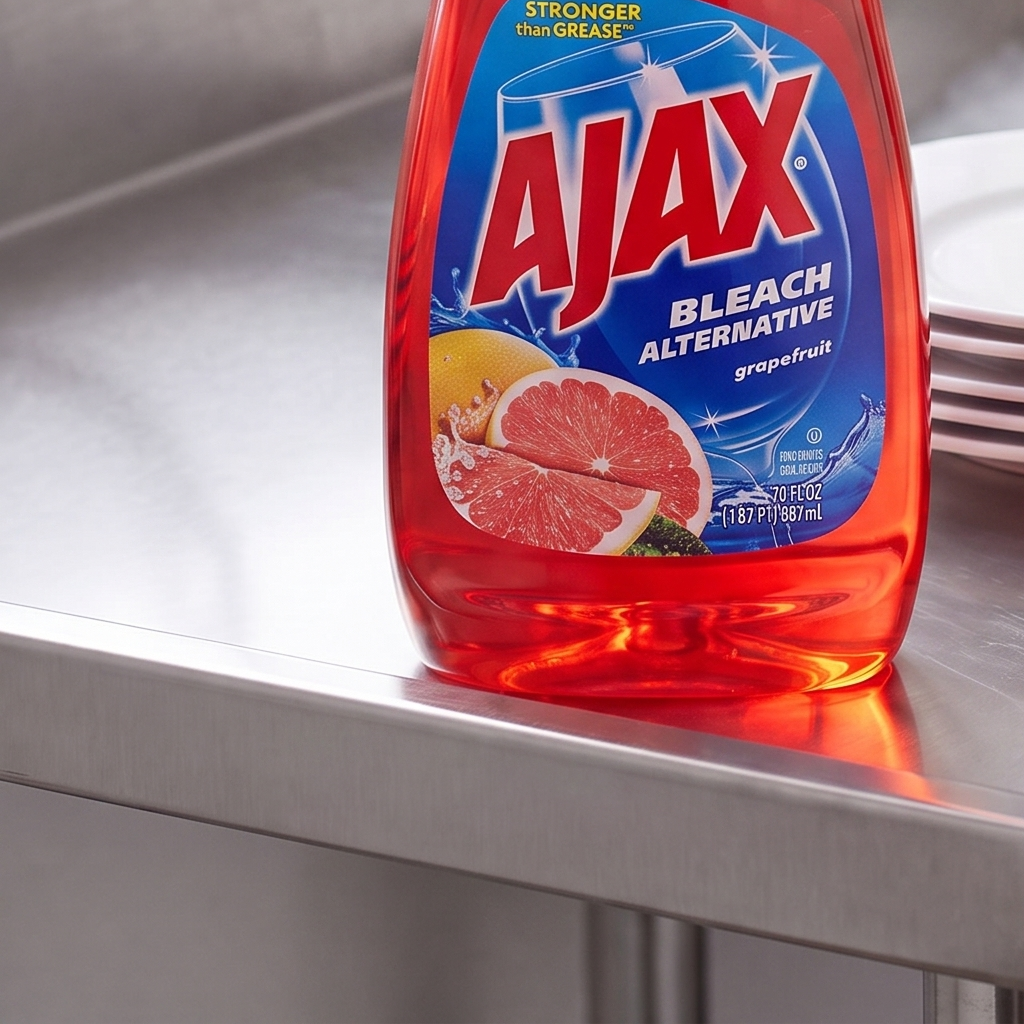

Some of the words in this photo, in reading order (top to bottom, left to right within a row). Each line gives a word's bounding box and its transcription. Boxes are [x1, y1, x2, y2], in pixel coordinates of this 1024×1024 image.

[515, 21, 550, 37] than
[525, 0, 642, 21] STRONGER
[469, 72, 819, 332] AJAX
[669, 261, 832, 329] BLEACH
[638, 295, 834, 365] ALTERNATIVE
[734, 339, 832, 382] grapefruit
